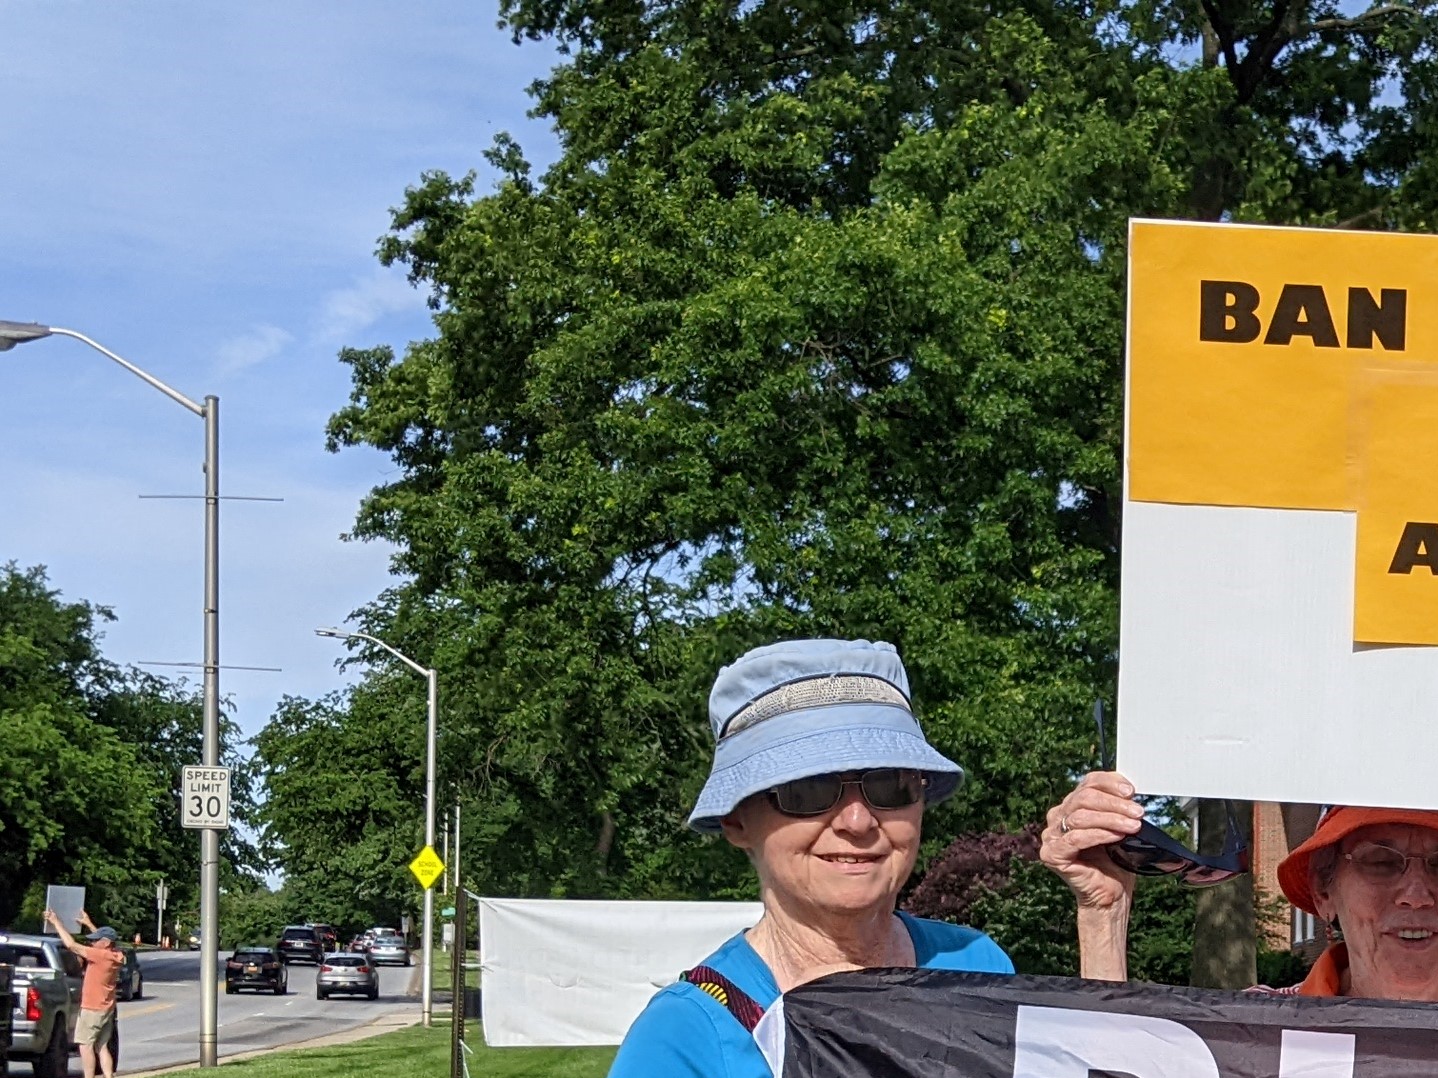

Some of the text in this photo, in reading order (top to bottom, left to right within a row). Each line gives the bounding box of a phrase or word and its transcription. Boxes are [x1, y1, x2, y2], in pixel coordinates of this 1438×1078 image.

[1199, 279, 1408, 351] BAN
[186, 770, 227, 781] SPEED
[190, 783, 222, 793] LIMIT
[189, 795, 221, 818] 30
